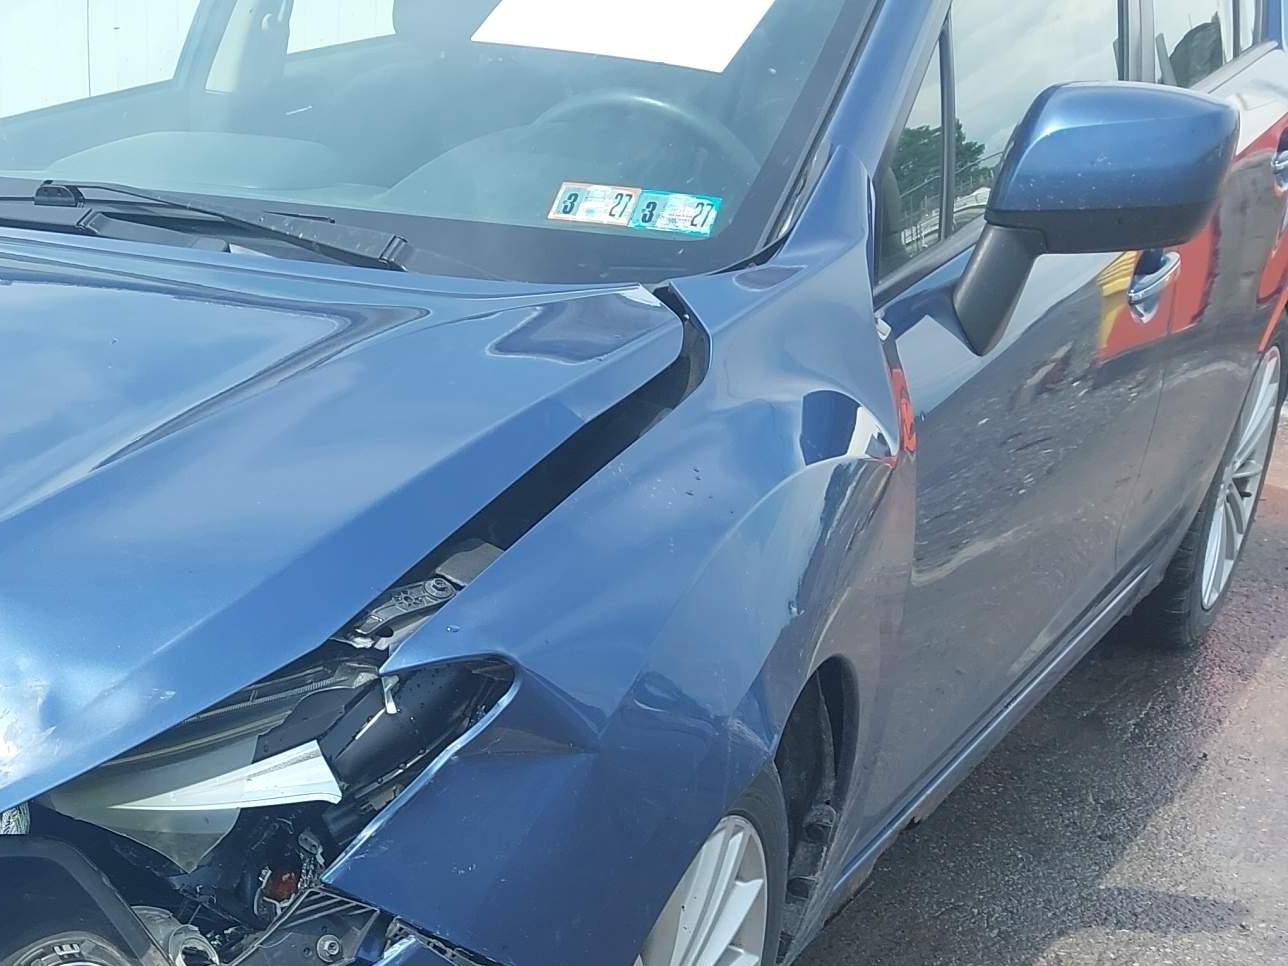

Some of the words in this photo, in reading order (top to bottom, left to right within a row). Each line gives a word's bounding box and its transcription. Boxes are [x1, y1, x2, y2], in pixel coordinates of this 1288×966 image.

[562, 193, 579, 214] 3
[609, 193, 633, 218] 27
[641, 201, 658, 223] 3
[690, 202, 714, 227] 27
